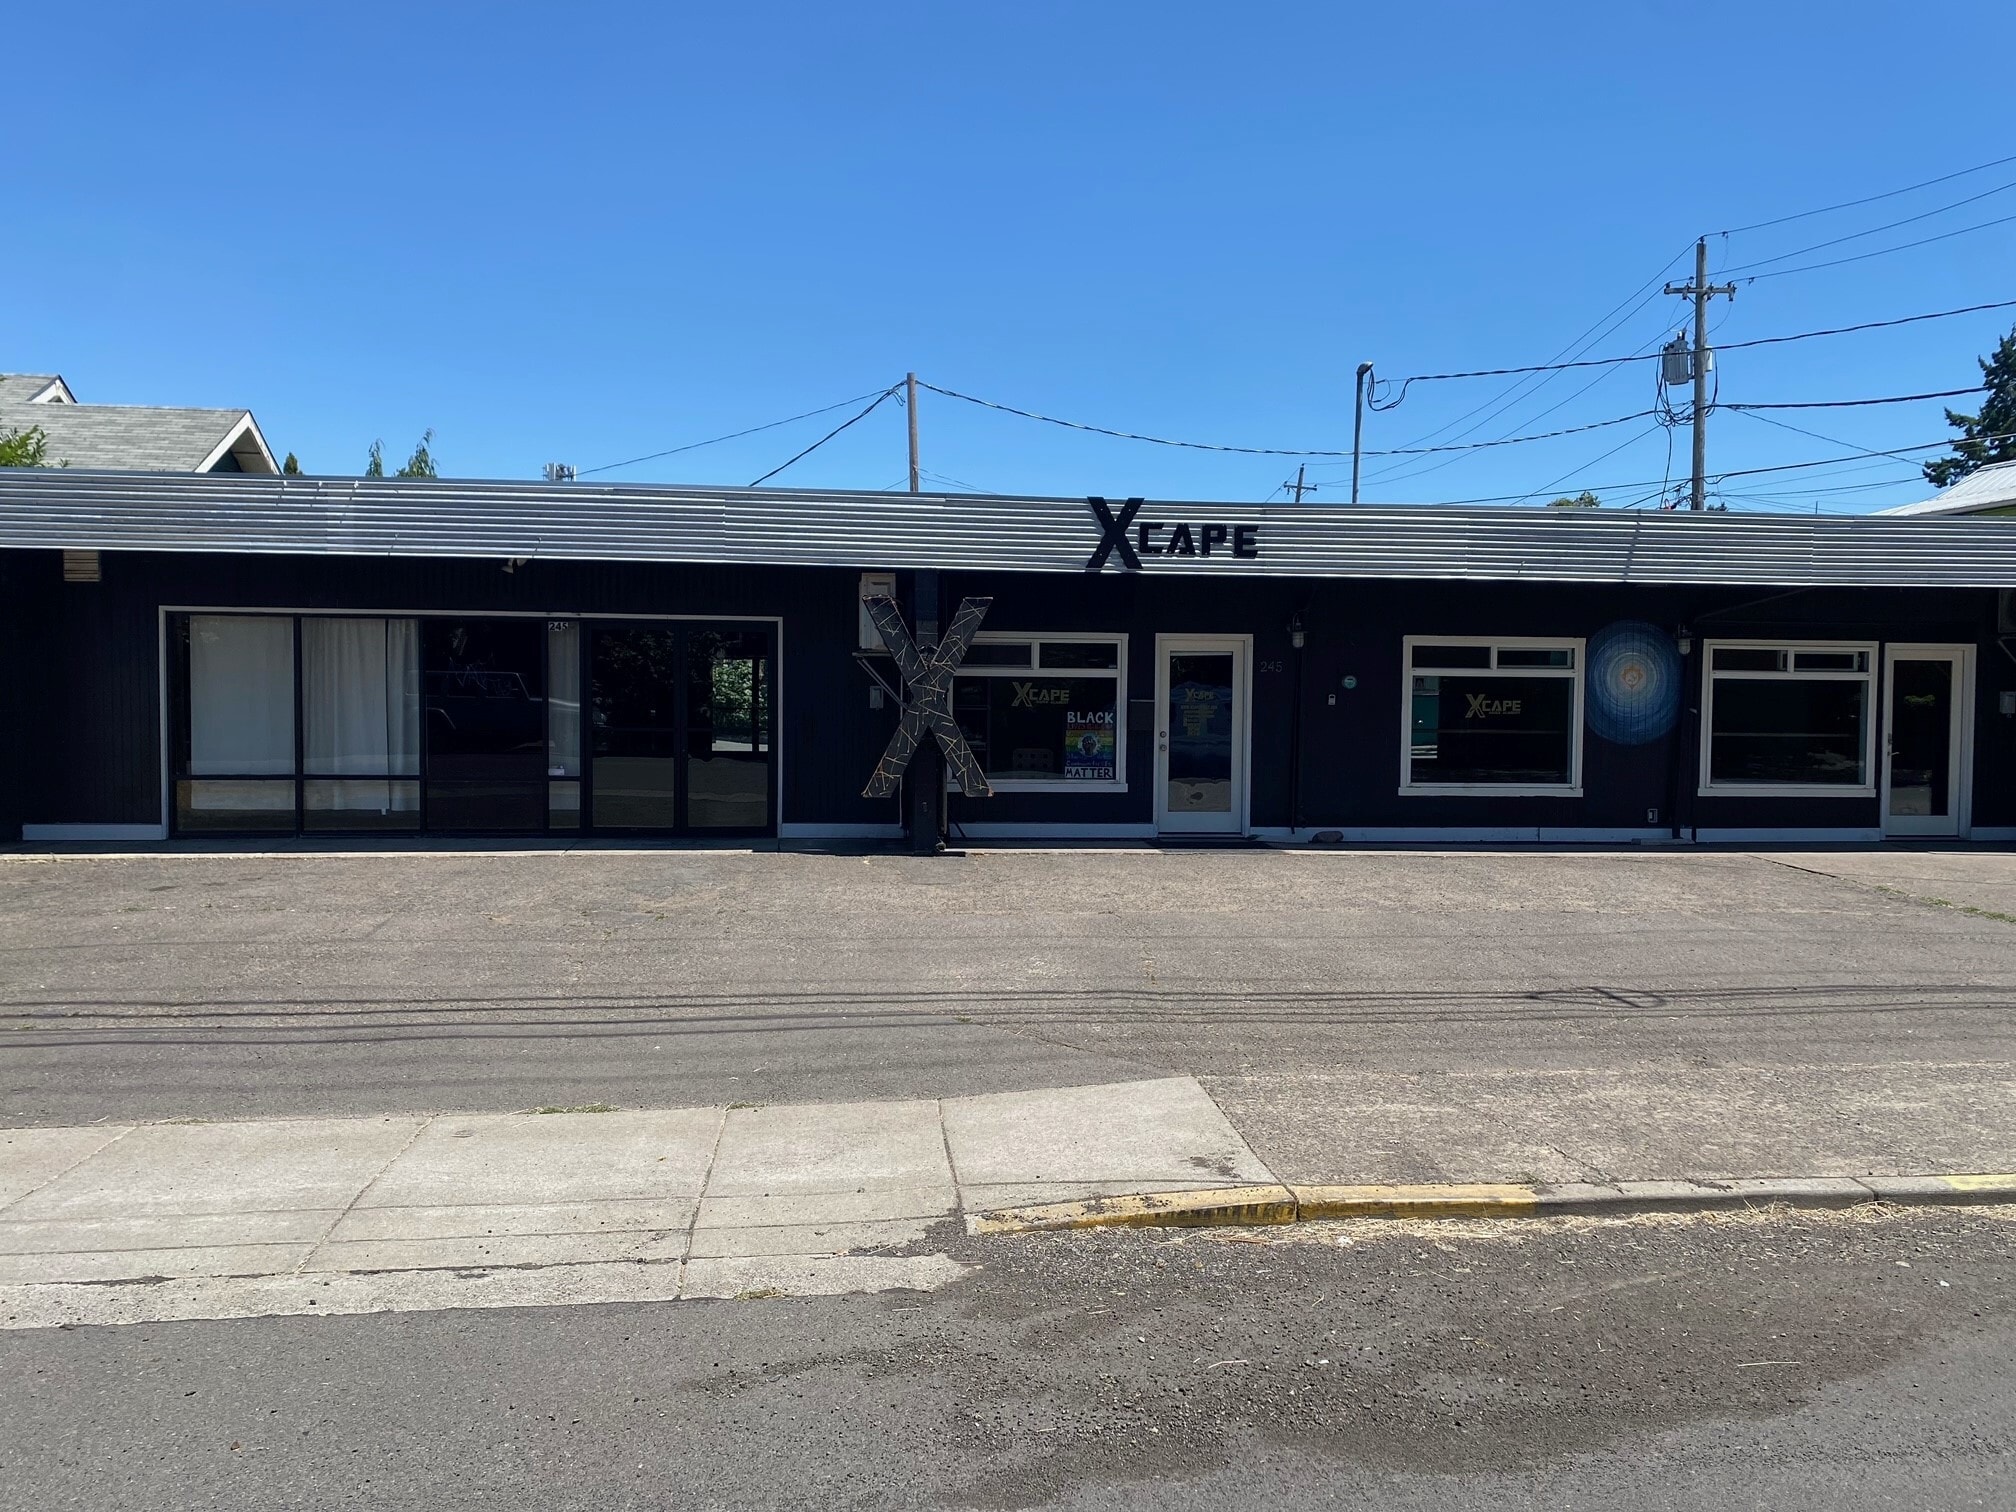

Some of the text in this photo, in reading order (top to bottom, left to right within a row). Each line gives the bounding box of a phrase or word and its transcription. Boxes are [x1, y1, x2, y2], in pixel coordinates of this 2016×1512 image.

[1086, 496, 1259, 569] XCAPE
[549, 622, 568, 631] 245
[1260, 661, 1282, 672] 245
[1011, 681, 1070, 707] XCAPE
[1465, 694, 1521, 718] XCAPE
[1067, 711, 1114, 724] BLACK
[1065, 767, 1112, 778] MATTER
